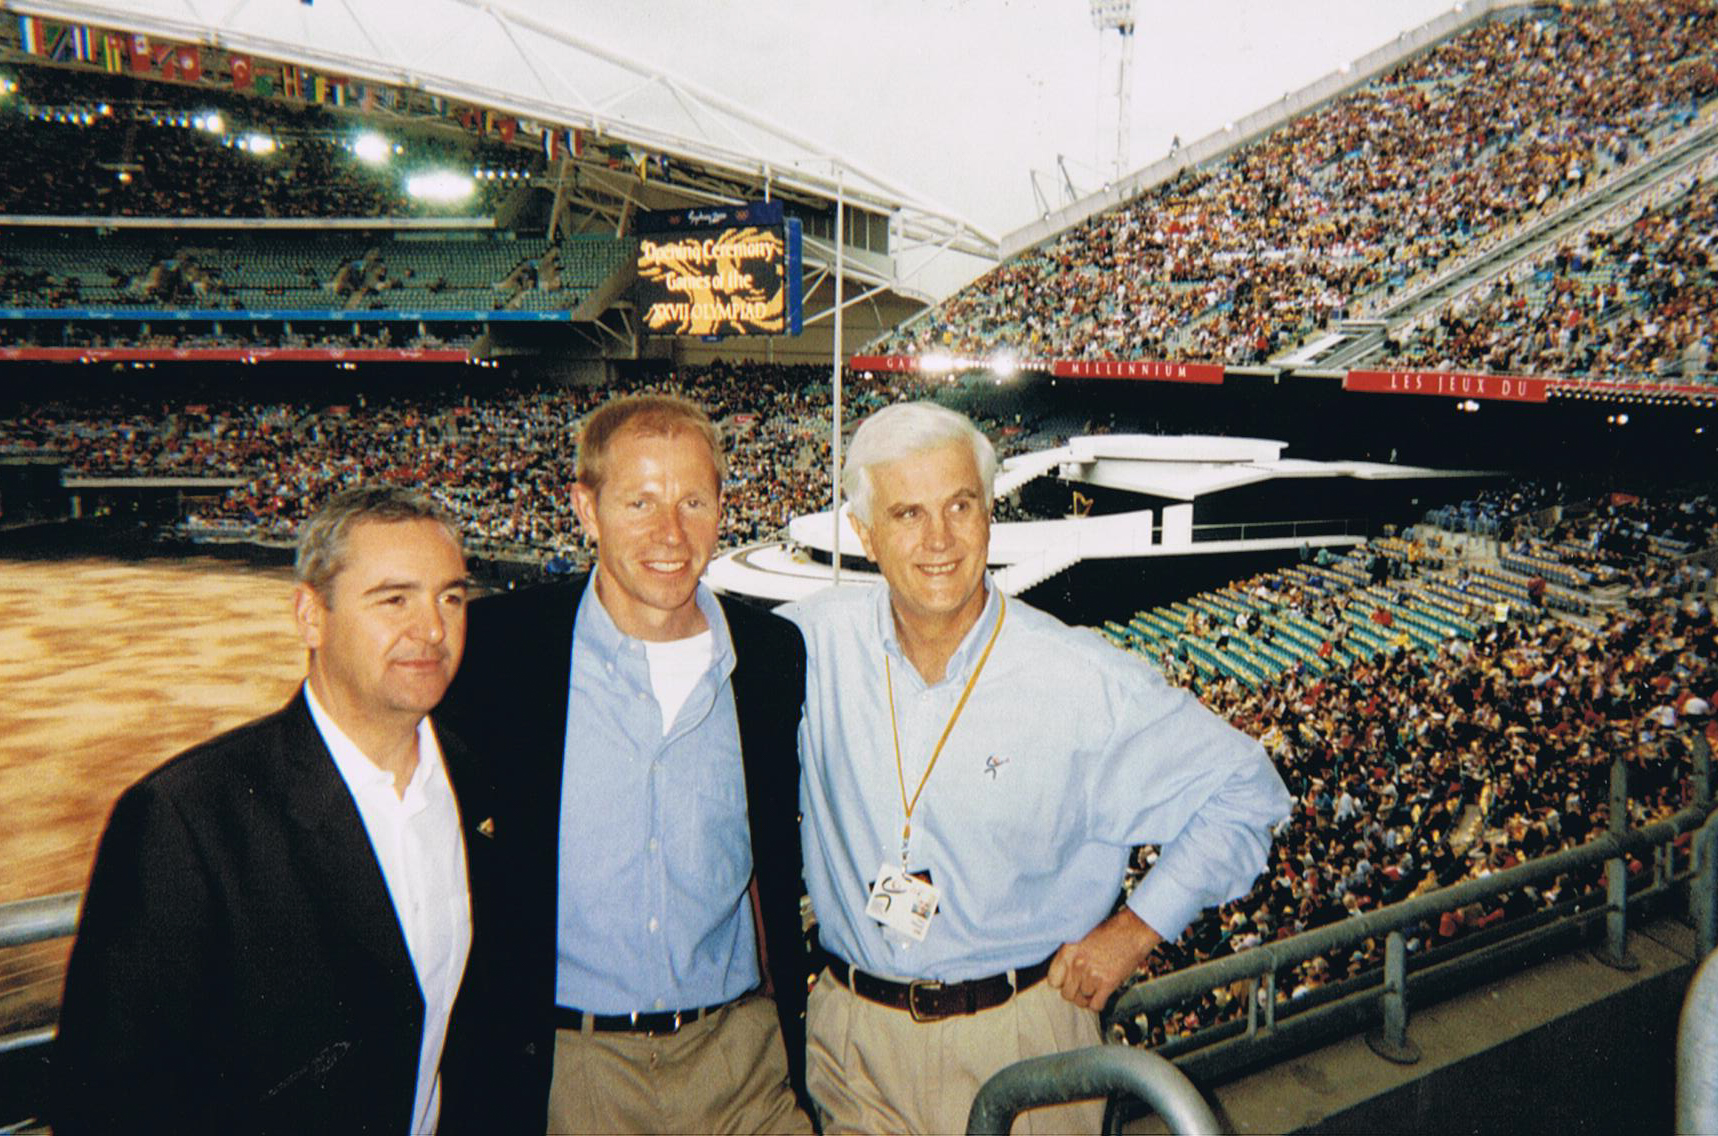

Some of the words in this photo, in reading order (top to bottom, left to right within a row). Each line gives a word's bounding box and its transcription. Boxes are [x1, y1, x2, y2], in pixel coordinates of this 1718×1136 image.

[643, 240, 702, 265] Opening
[702, 239, 775, 262] Ceremony
[666, 271, 711, 290] Games
[712, 270, 725, 290] of
[727, 271, 753, 290] the
[652, 303, 690, 321] XXVII
[690, 302, 768, 321] OLYMPIAD
[1072, 361, 1187, 378] MILLENNIUM
[1391, 374, 1422, 390] LES
[1438, 376, 1485, 394] JEUX
[1501, 379, 1527, 397] DU
